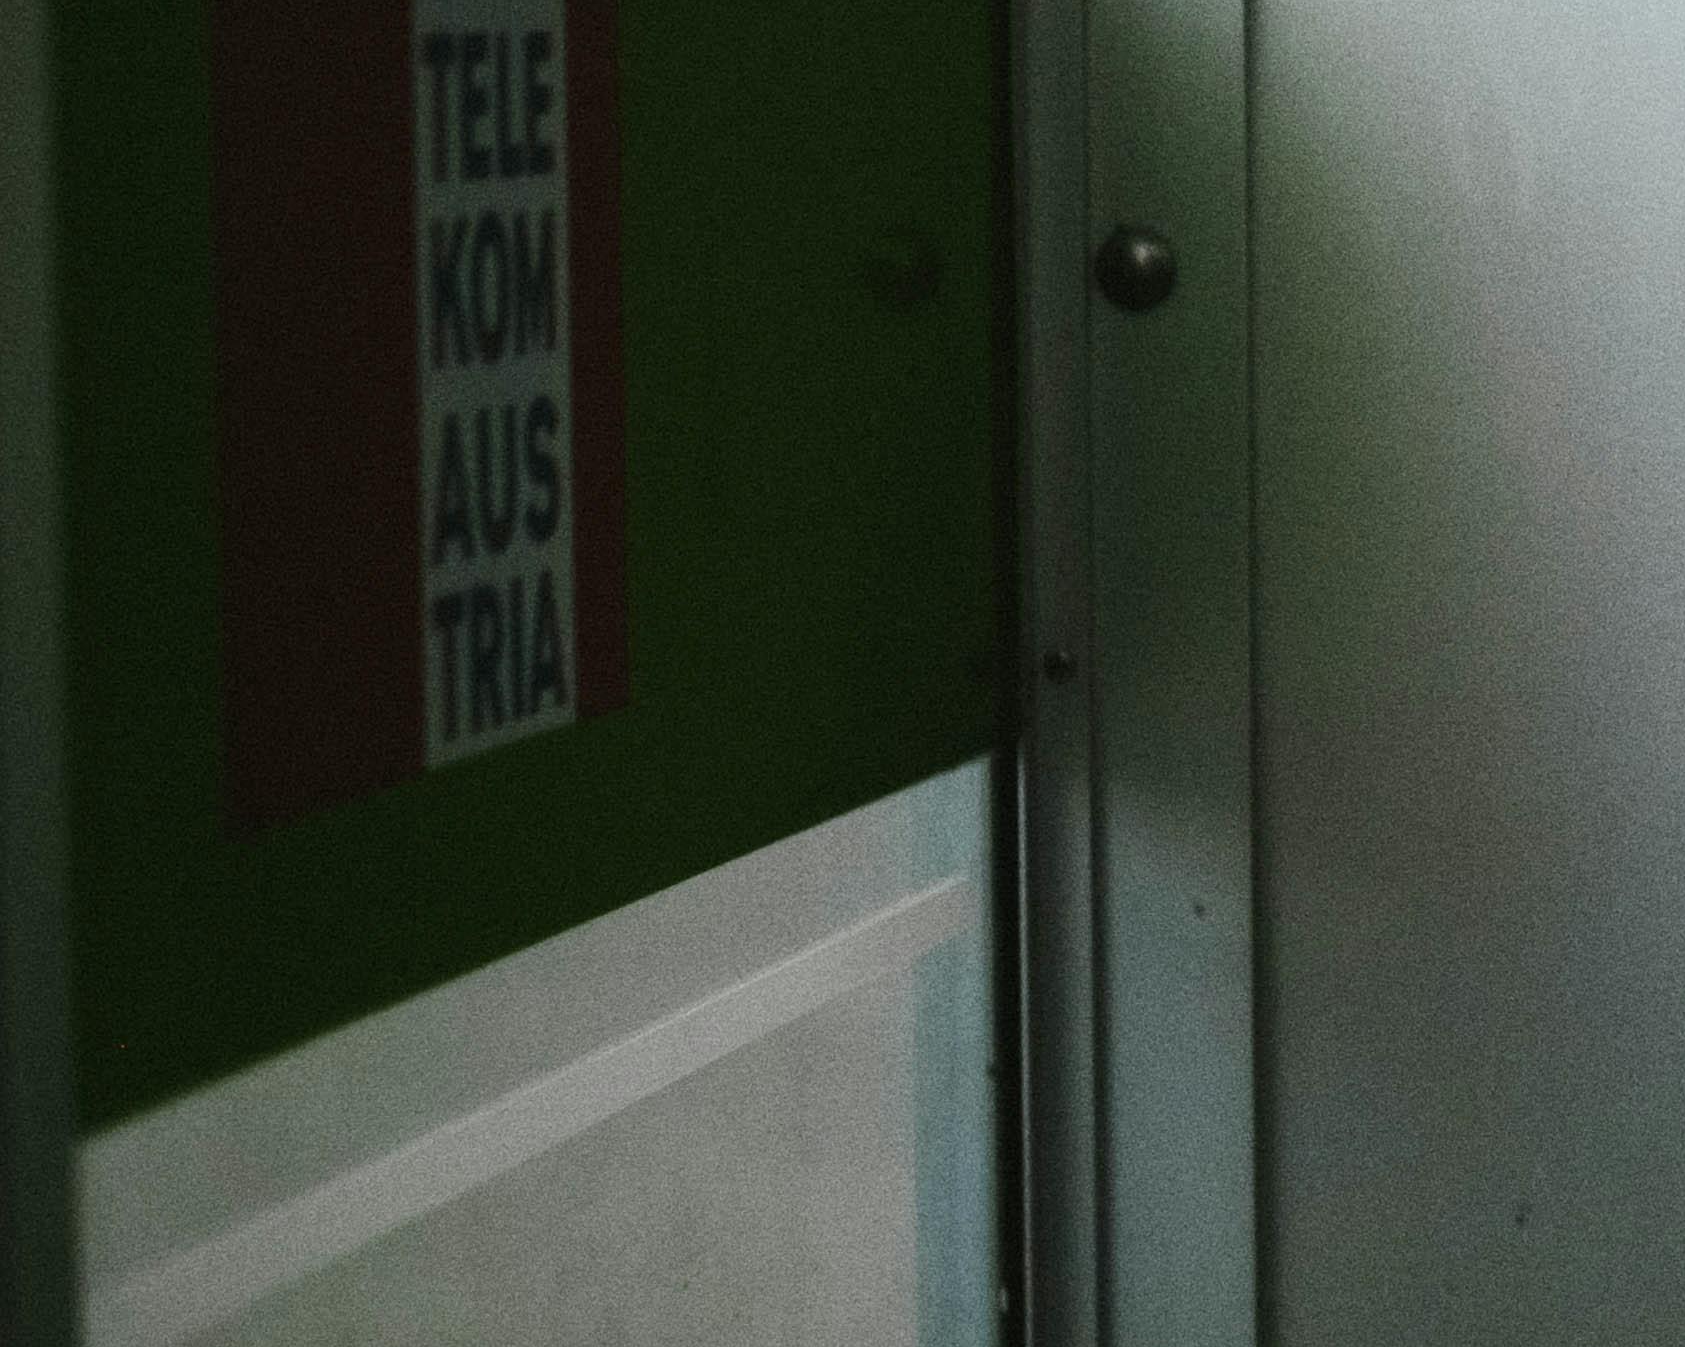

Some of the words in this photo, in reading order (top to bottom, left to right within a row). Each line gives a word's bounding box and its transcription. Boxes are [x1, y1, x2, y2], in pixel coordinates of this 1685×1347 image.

[421, 30, 557, 186] TELE
[427, 208, 559, 373] KOM
[430, 393, 561, 568] AUS
[430, 569, 567, 747] TRIA
